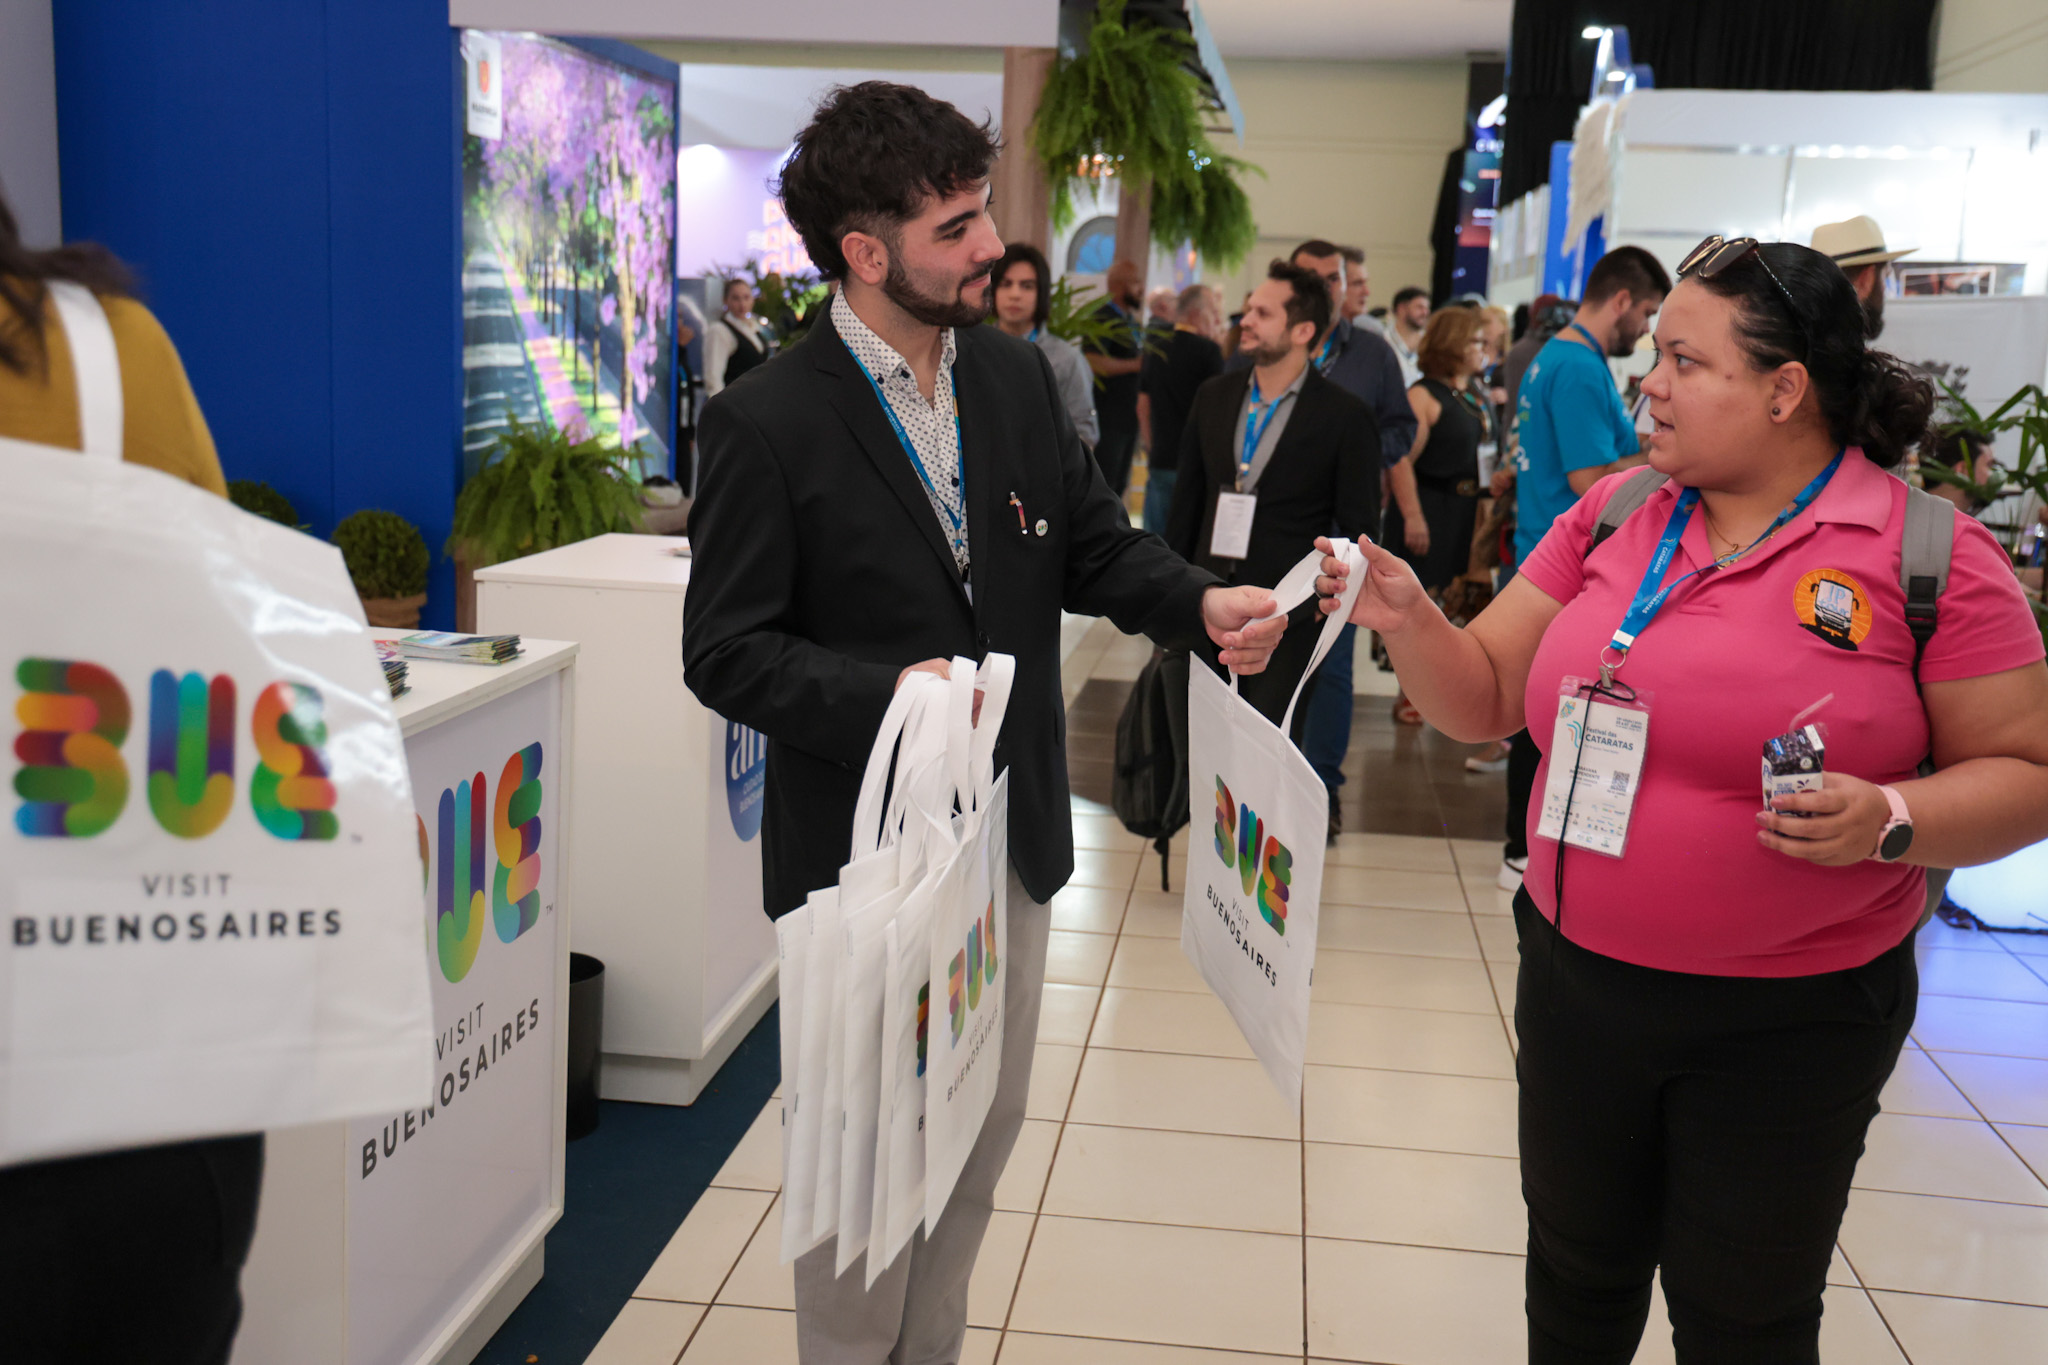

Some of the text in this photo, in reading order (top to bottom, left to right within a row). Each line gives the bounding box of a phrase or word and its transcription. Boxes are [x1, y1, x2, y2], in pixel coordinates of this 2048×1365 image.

[1585, 734, 1634, 751] CATARATAS
[417, 741, 543, 984] UE
[142, 873, 233, 899] VISIT
[12, 909, 343, 947] BUENOSAIRES
[1232, 897, 1250, 931] VISIT
[1207, 884, 1277, 987] BUENOSAIRES
[436, 1002, 484, 1061] VISIT
[968, 1014, 984, 1047] VISIT
[947, 1003, 999, 1102] BUENOSAIRES
